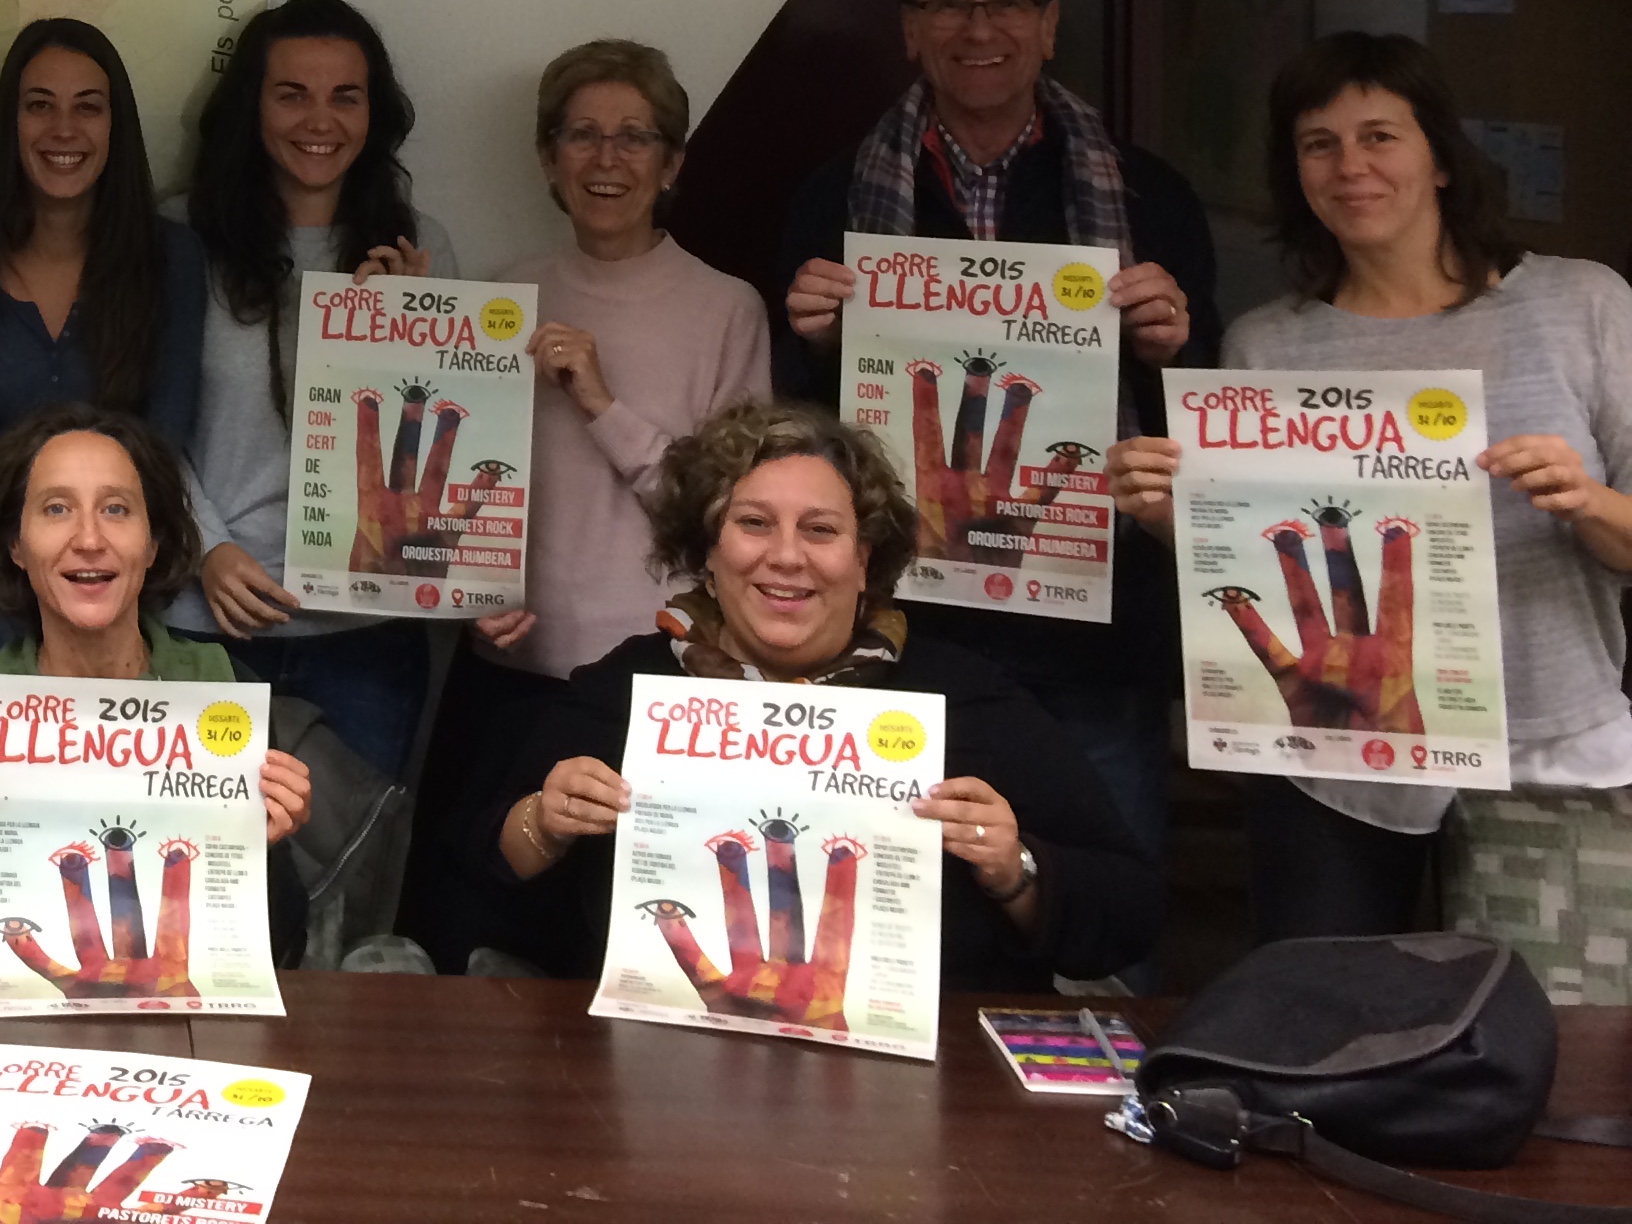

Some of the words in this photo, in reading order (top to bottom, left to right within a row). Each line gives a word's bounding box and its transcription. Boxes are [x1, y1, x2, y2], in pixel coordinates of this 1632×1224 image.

[211, 37, 234, 75] Els
[857, 252, 939, 278] CORRE
[960, 257, 1026, 280] 2015
[313, 288, 384, 312] CORRE
[403, 292, 458, 314] 2015
[868, 271, 1049, 321] LLENGUA
[1060, 286, 1095, 299] 31/10
[321, 305, 476, 350] LLENGUA
[858, 357, 894, 376] GRAN
[309, 387, 342, 403] GRAN
[857, 384, 891, 400] CON-
[1181, 386, 1276, 413] CORRE
[1298, 387, 1374, 410] 2015
[307, 411, 337, 426] CON-
[856, 409, 891, 426] CERT
[1198, 407, 1406, 453] LLENGUA
[306, 434, 337, 451] CERT
[305, 458, 321, 473] DE
[303, 482, 333, 498] CAS-
[1030, 470, 1044, 485] DJ
[1047, 472, 1099, 491] MISTERY
[457, 488, 469, 502] DJ
[470, 488, 515, 504] MISTERY
[302, 506, 331, 522] TAN-
[996, 501, 1064, 523] PASTORETS
[1065, 508, 1098, 525] ROCK
[427, 516, 484, 534] PASTORETS
[486, 519, 513, 535] ROCK
[301, 529, 333, 547] YADA
[968, 531, 1037, 551] ORQUESTRA
[1038, 537, 1098, 559] RUMBERA
[402, 545, 460, 563] ORQUESTRA
[462, 549, 512, 566] RUMBERA
[466, 592, 505, 606] TRRG
[1043, 584, 1088, 603] TRRG
[99, 697, 170, 723] 2015
[647, 697, 741, 727] CORRE
[762, 702, 838, 730] 2015
[207, 728, 242, 742] 31/10
[876, 736, 916, 750] 31/10
[656, 720, 861, 772] LLENGUA
[1432, 749, 1483, 767] TRRG
[108, 1066, 191, 1087] 2015
[153, 1193, 171, 1204] DJ
[173, 1195, 248, 1213] MISTERY
[98, 1207, 192, 1224] PASTORETS
